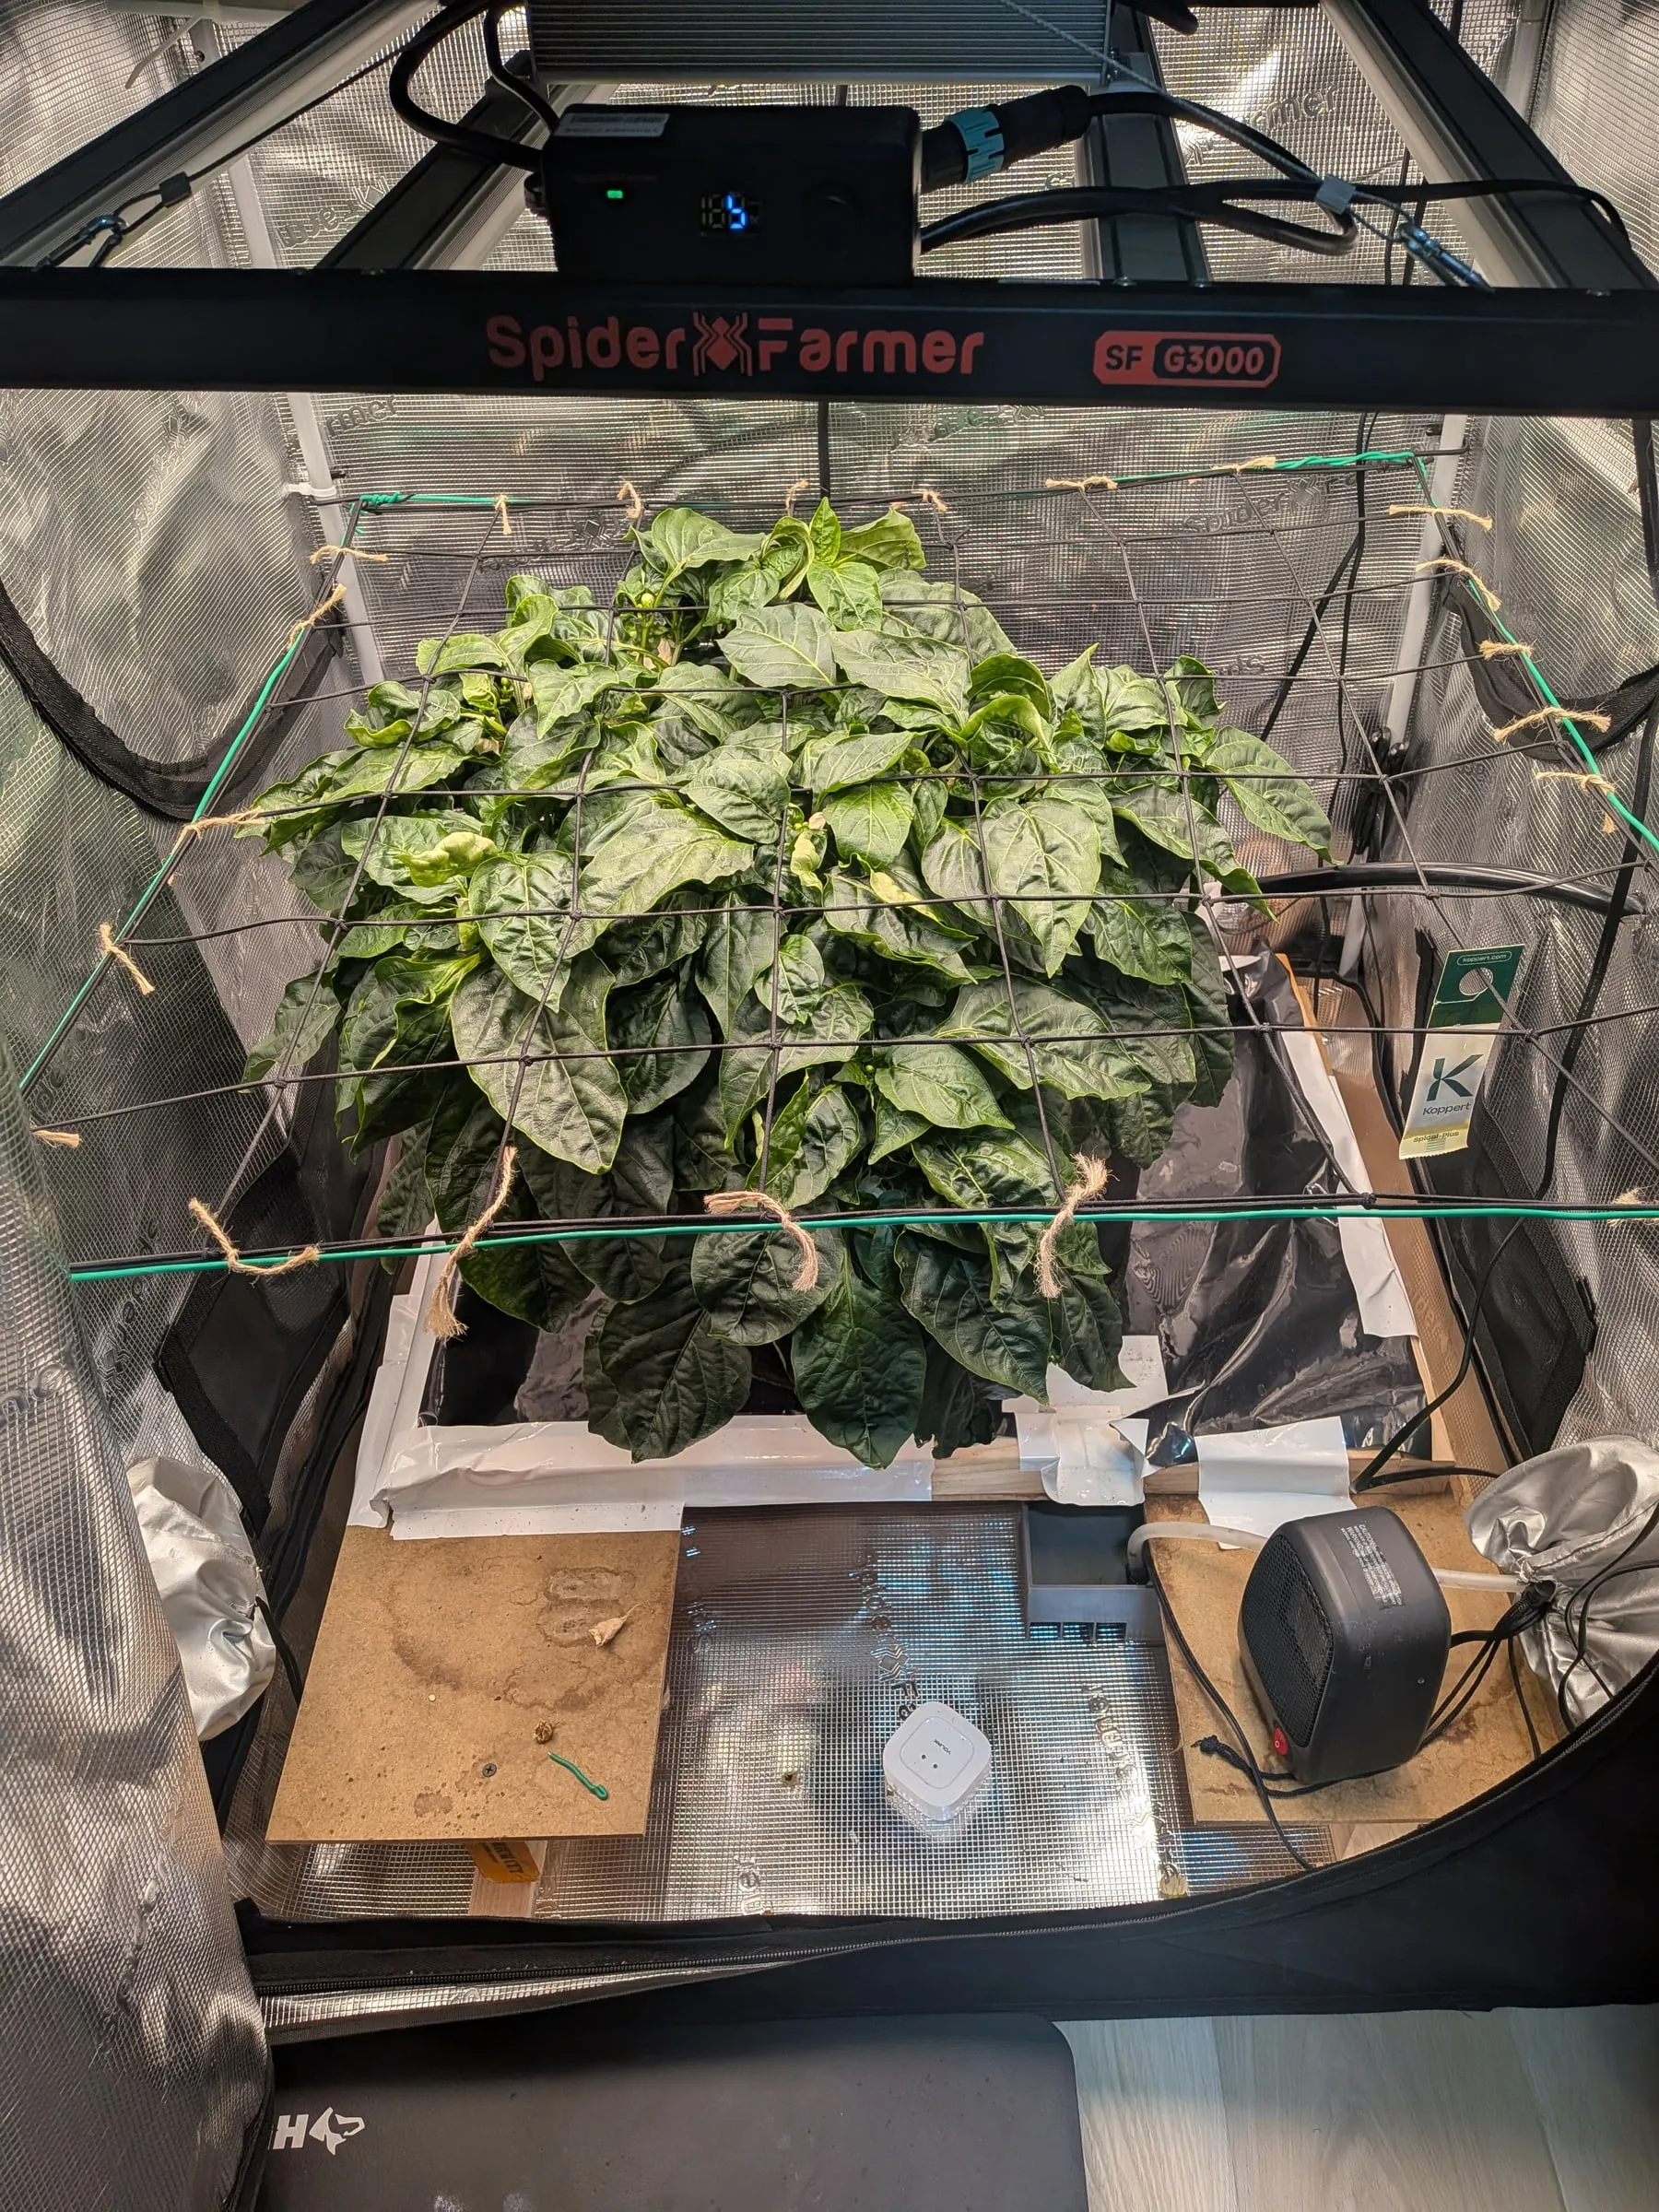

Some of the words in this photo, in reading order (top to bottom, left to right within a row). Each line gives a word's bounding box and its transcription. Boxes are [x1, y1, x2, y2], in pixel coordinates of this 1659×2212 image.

[486, 314, 686, 382] Spider
[758, 317, 985, 375] Farmer
[1105, 344, 1144, 371] SF
[1163, 344, 1265, 375] G3000
[1463, 953, 1507, 963] koppert.com
[1422, 1102, 1472, 1115] Koppert
